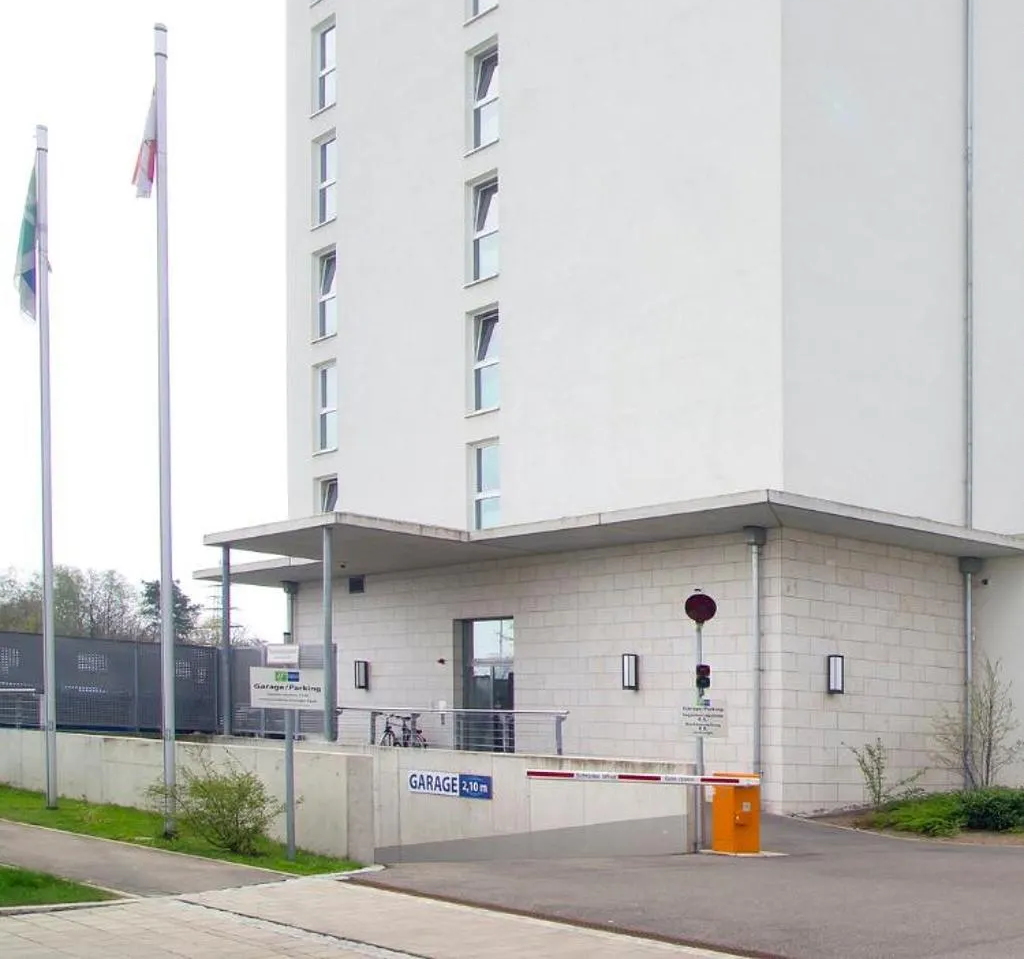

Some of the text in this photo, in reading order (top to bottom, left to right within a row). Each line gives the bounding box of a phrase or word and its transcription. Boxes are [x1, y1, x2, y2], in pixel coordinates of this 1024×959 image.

[409, 774, 488, 793] GARAGE 2,10 m
